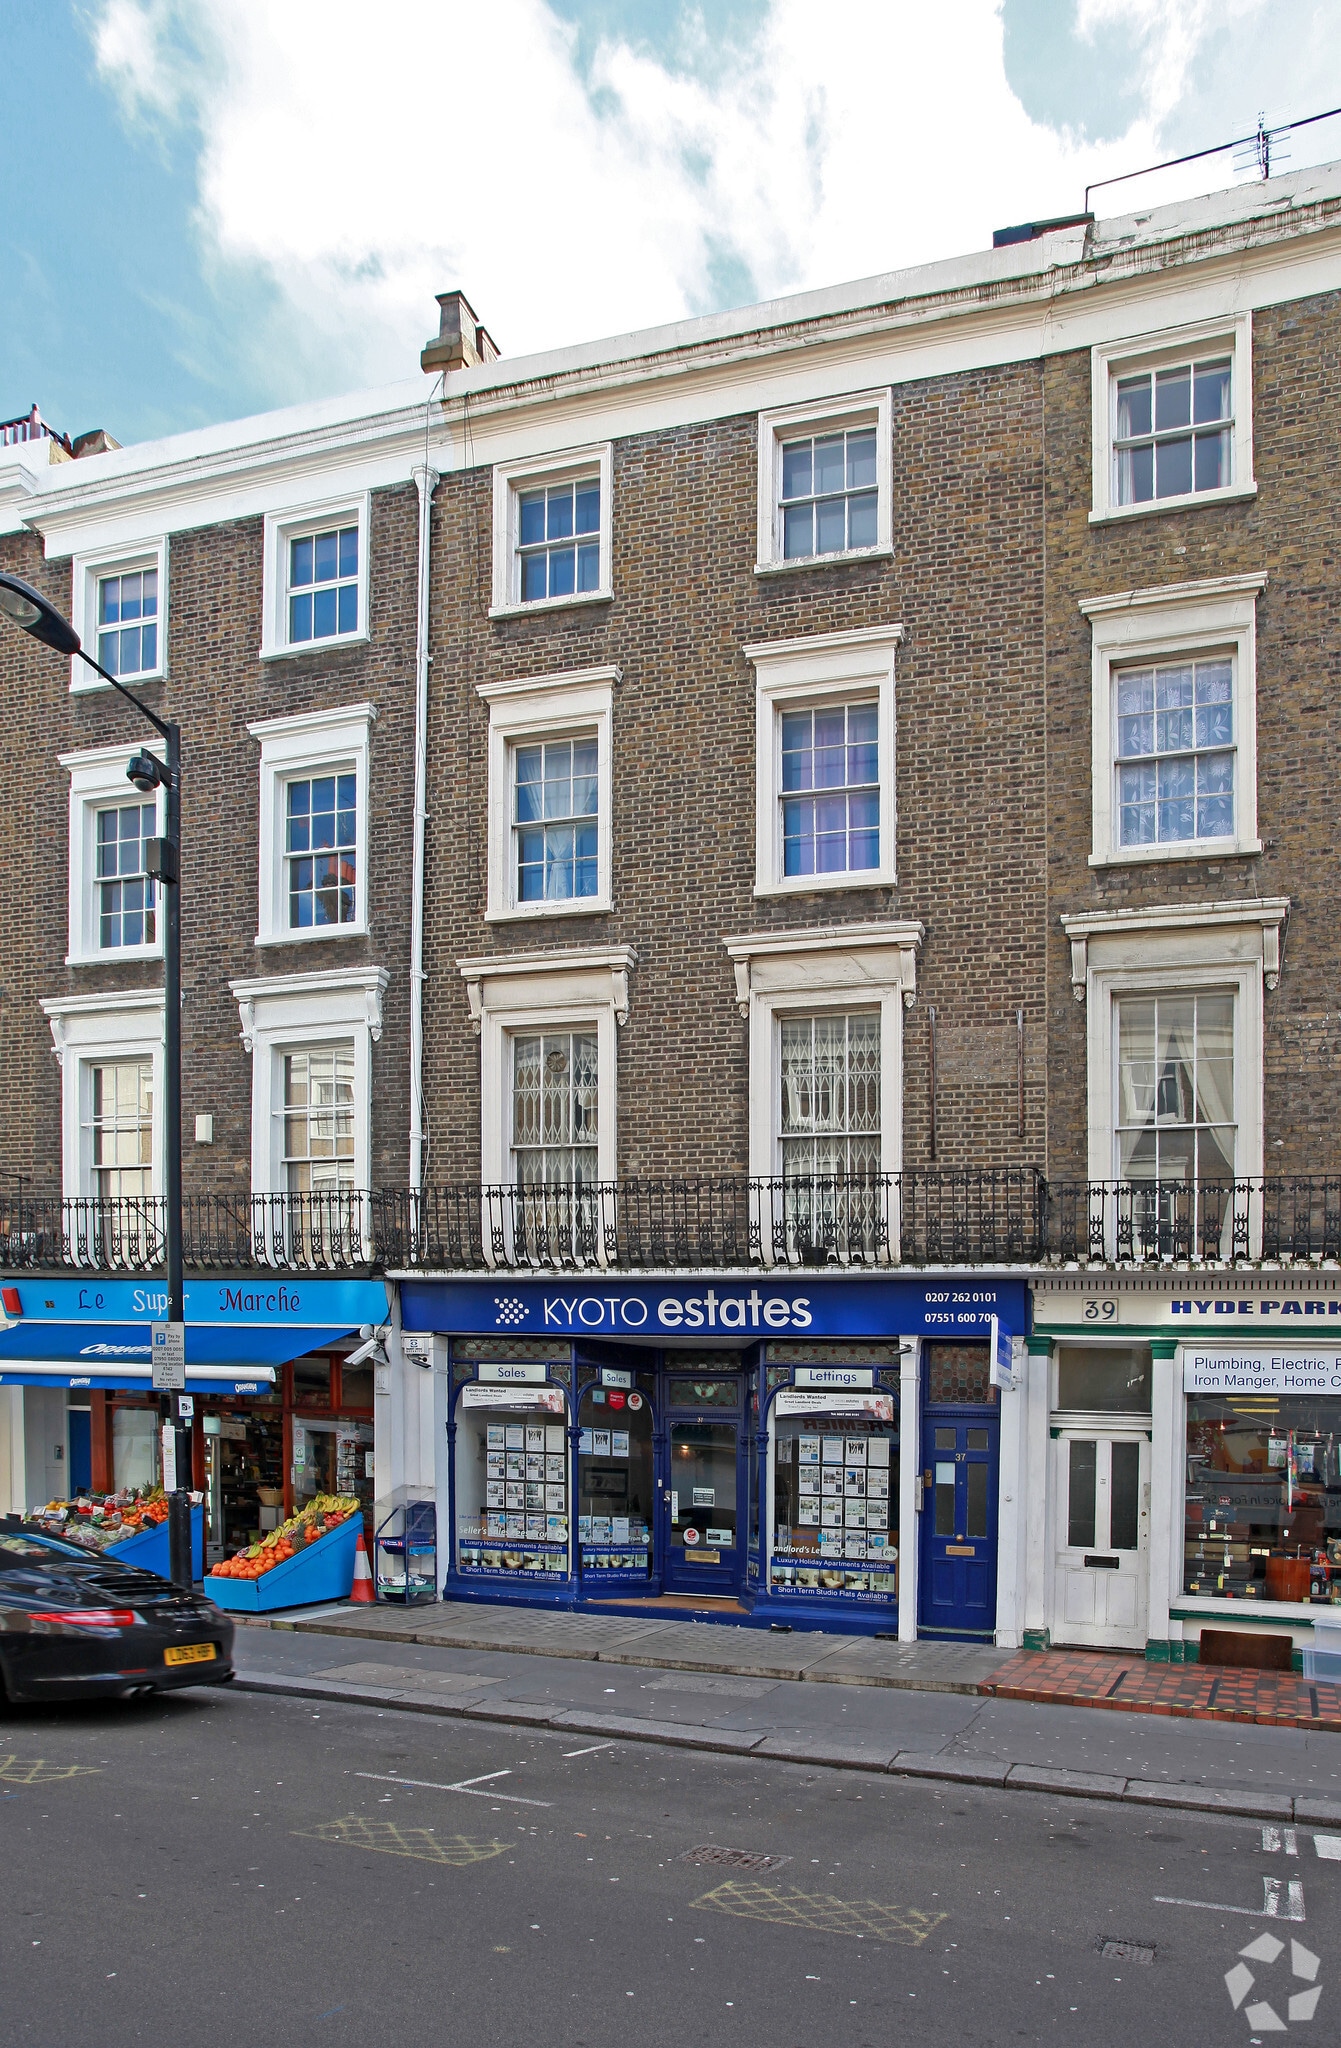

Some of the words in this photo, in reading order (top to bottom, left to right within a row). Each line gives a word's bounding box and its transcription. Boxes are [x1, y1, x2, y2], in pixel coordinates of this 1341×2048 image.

[78, 1289, 107, 1310] Le
[132, 1289, 190, 1317] Supr
[219, 1286, 303, 1312] Marché
[925, 1292, 950, 1303] 0207
[951, 1292, 971, 1303] 262
[972, 1292, 997, 1303] 0101
[543, 1297, 648, 1326] KYOTO
[657, 1289, 813, 1328] estates
[1085, 1301, 1115, 1320] 39
[1171, 1300, 1254, 1315] HYDE
[1260, 1300, 1341, 1315] PARK
[924, 1312, 955, 1323] 07551
[957, 1312, 977, 1323] 600
[157, 1334, 165, 1344] P
[1194, 1357, 1266, 1373] Plumbing,
[1271, 1357, 1329, 1372] Electric,
[497, 1367, 526, 1378] Sales
[606, 1373, 627, 1384] Sales
[809, 1370, 857, 1384] Lettings
[1194, 1375, 1220, 1386] Iron
[1224, 1375, 1279, 1389] Manger,
[1284, 1375, 1326, 1387] Home
[955, 1452, 966, 1462] 37
[464, 1539, 483, 1547] Luxury
[484, 1541, 504, 1549] Holiday
[505, 1542, 537, 1551] Apartments
[773, 1545, 810, 1554] andlord's
[776, 1557, 798, 1565] Luxury
[799, 1558, 822, 1567] Holiday
[823, 1559, 860, 1568] Apartments
[861, 1562, 891, 1570] Available
[498, 1568, 518, 1576] Studio
[777, 1586, 797, 1594] Short
[797, 1586, 816, 1595] Term
[815, 1588, 838, 1597] Studio
[856, 1592, 889, 1600] Available
